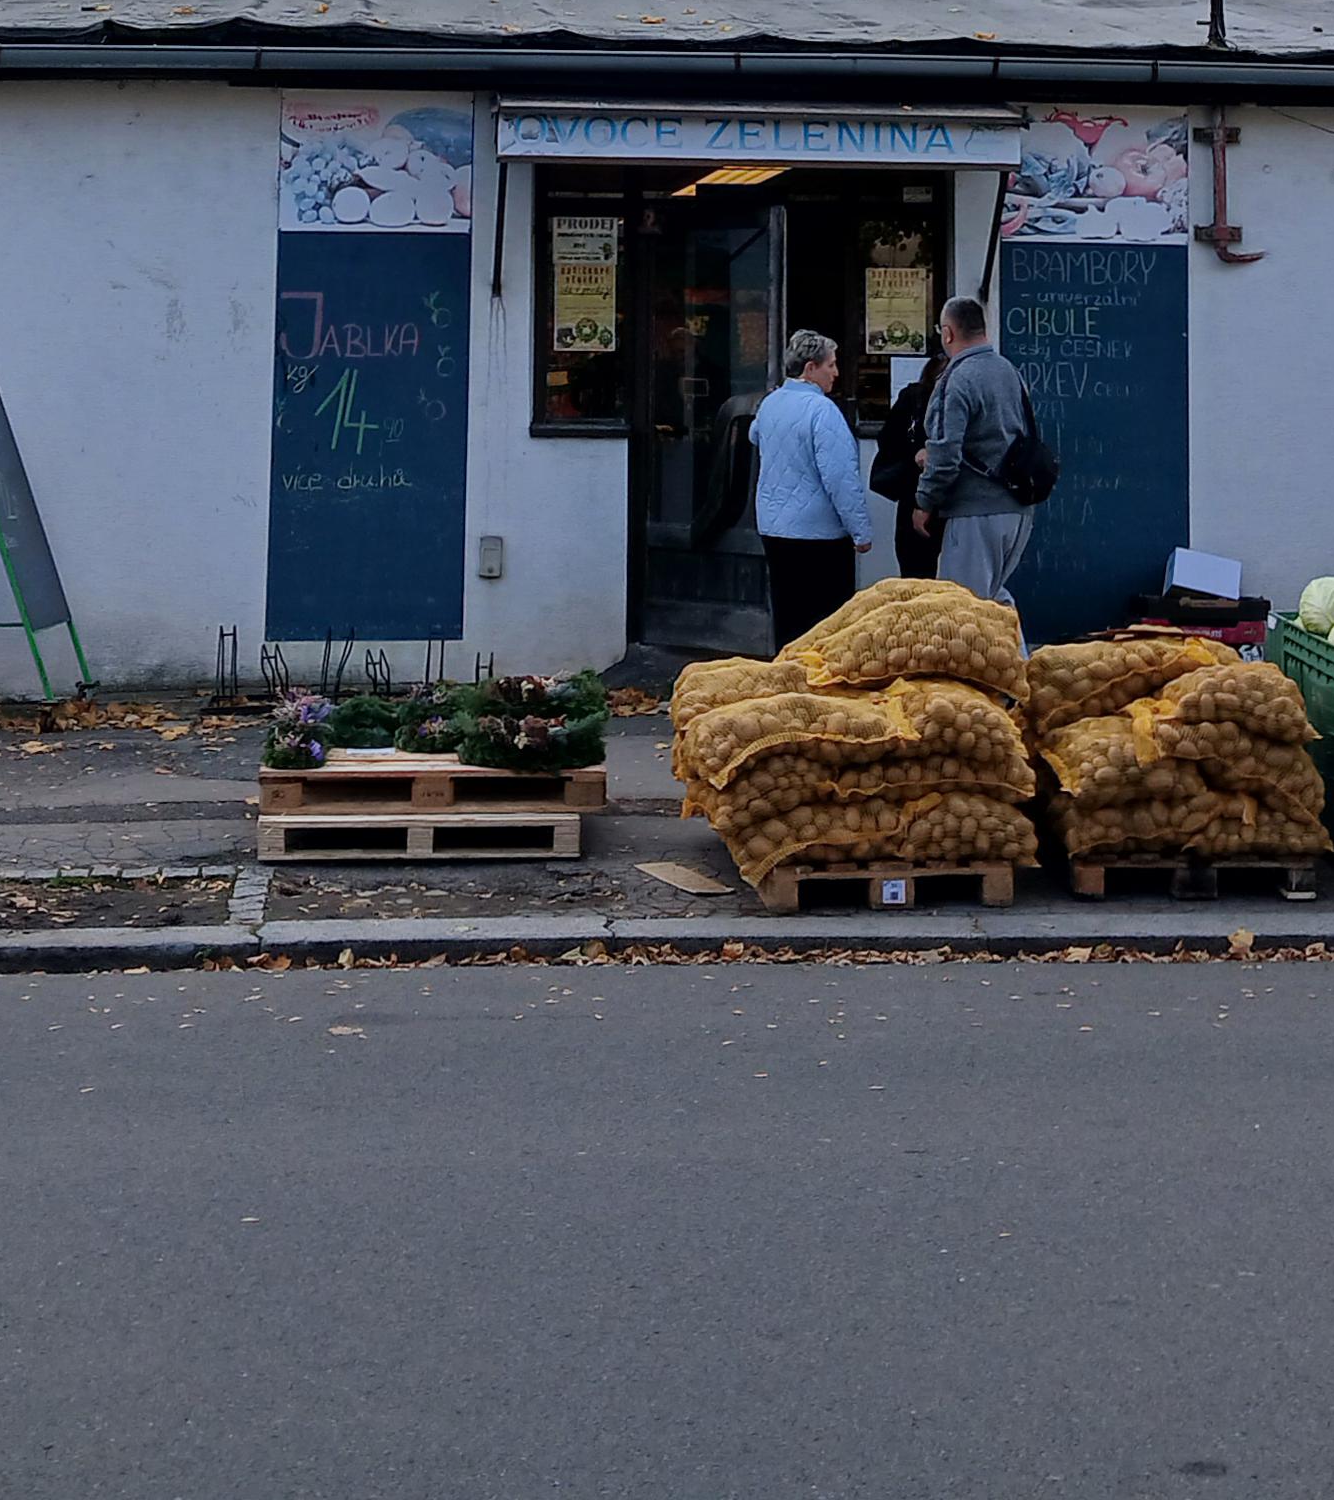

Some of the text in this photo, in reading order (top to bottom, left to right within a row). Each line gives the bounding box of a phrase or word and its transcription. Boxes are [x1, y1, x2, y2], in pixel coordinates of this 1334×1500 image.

[517, 114, 955, 155] OVOCE ZELENINA
[557, 218, 614, 231] PRODEJ
[1012, 248, 1157, 285] BRAMBORY
[280, 291, 420, 360] JABLKA
[1006, 307, 1101, 338] CIBULE
[337, 462, 413, 490] druhů
